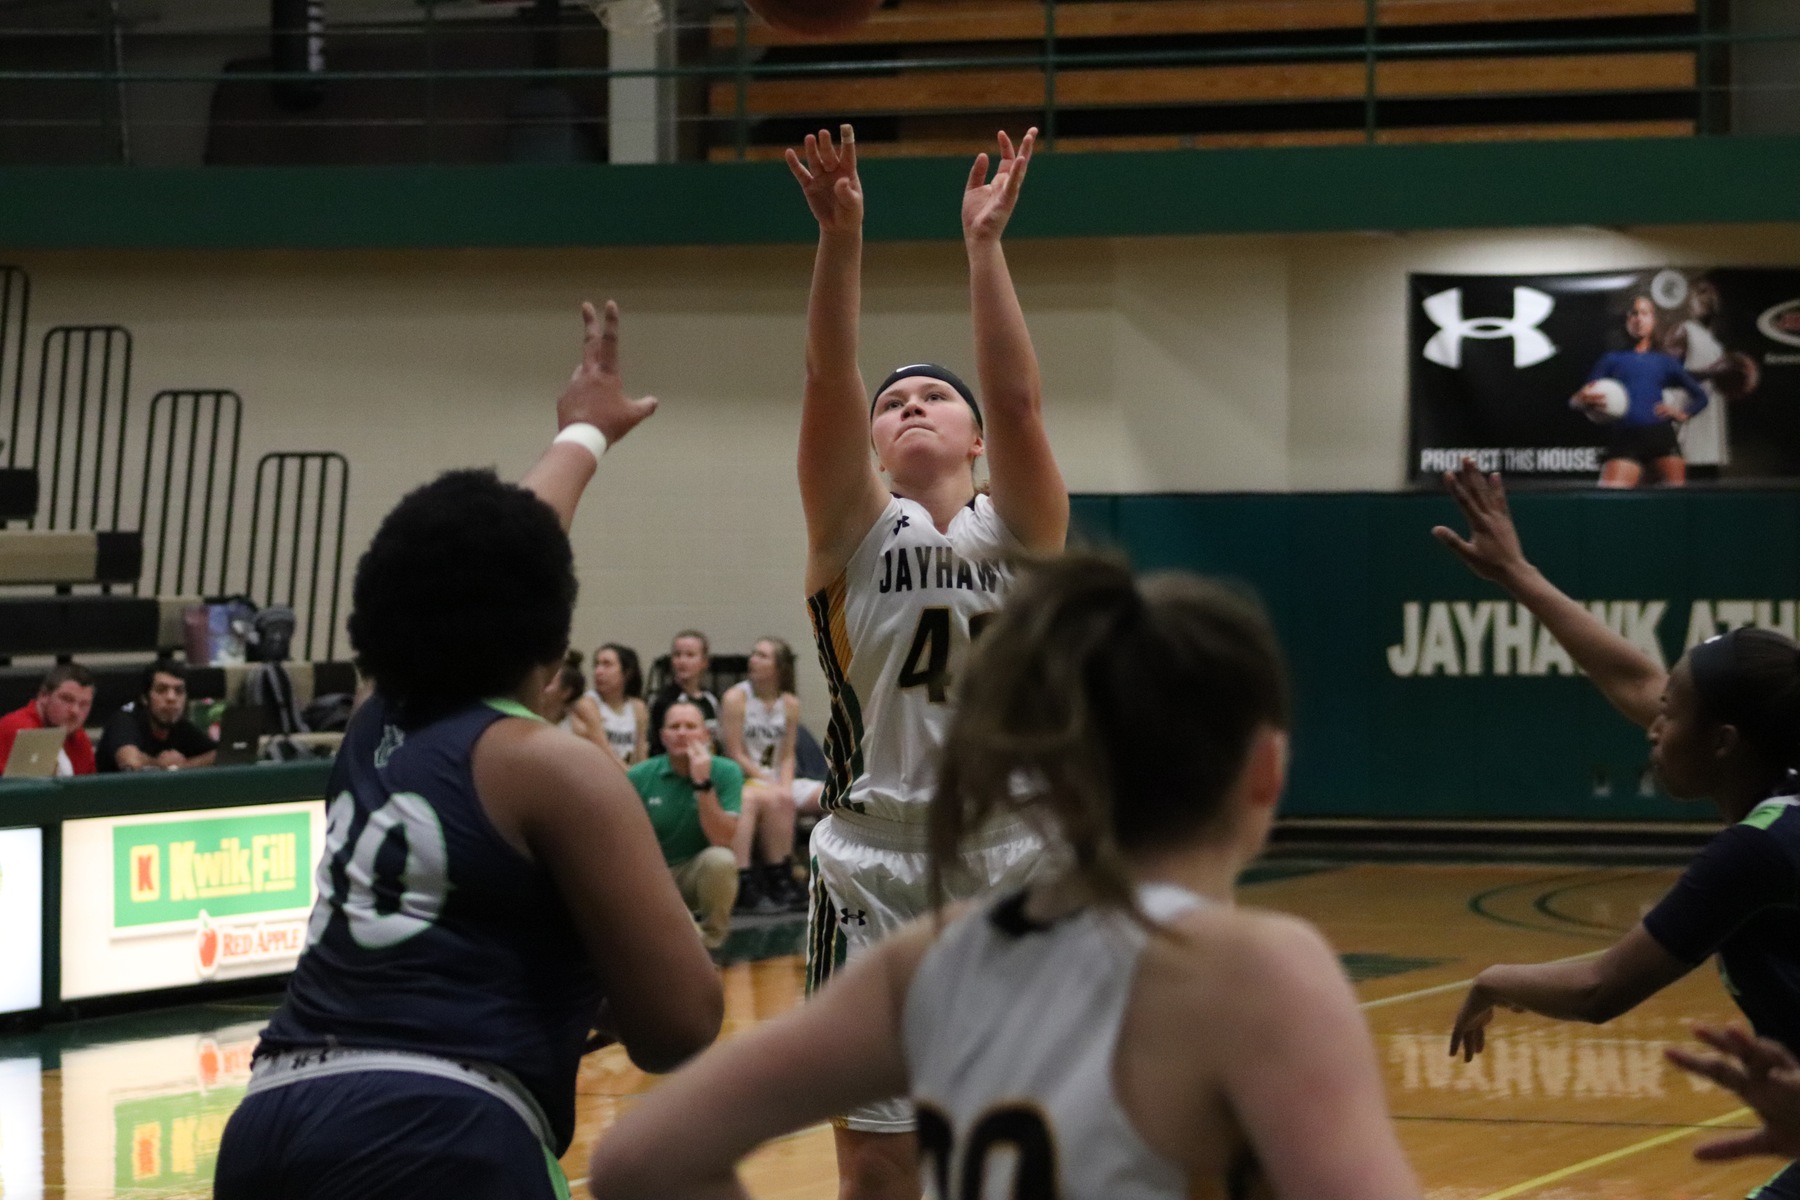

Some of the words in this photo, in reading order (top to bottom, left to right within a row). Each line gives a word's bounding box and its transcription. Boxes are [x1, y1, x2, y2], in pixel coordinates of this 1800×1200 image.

[1504, 448, 1535, 471] THIS
[879, 546, 1001, 594] JAYHAW
[898, 605, 1000, 704] 4
[222, 933, 253, 957] RED
[257, 929, 300, 953] APPLE
